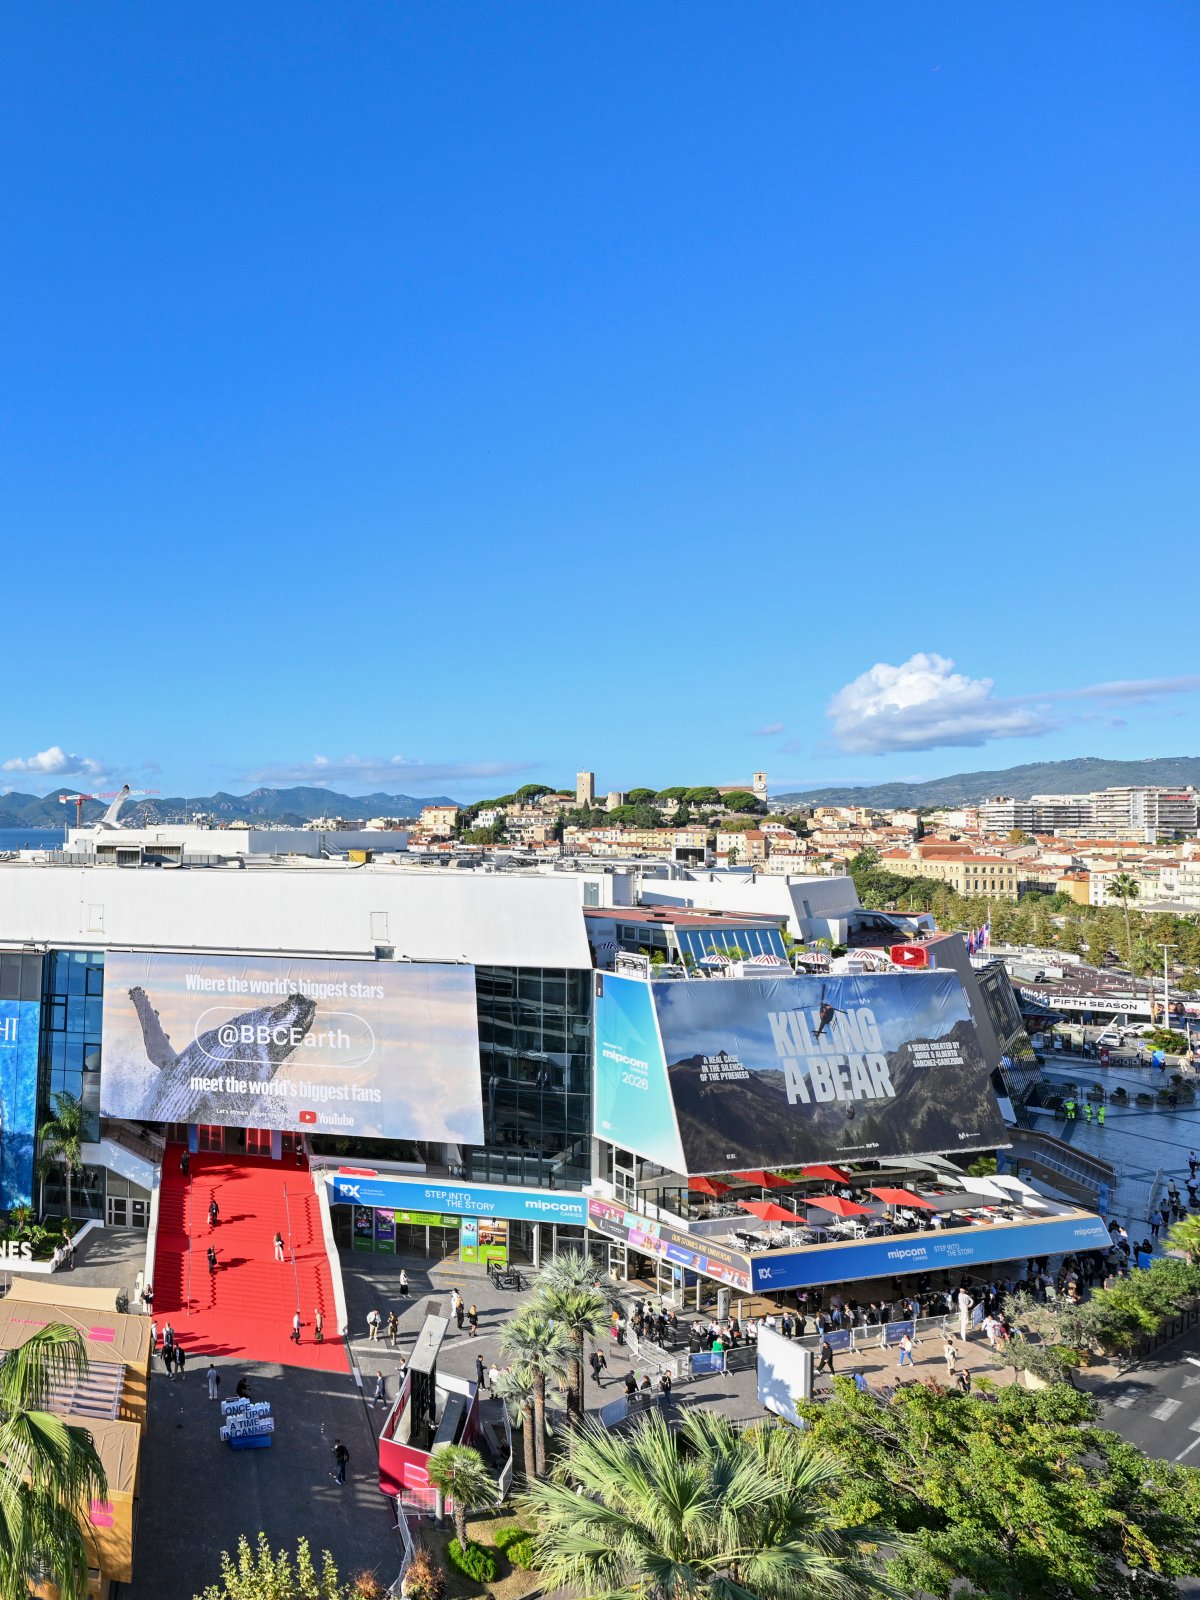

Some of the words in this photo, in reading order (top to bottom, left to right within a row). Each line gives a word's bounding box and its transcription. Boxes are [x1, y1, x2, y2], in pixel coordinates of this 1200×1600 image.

[186, 974, 225, 992] Where
[226, 978, 249, 994] the
[250, 979, 298, 995] world's
[299, 980, 348, 1000] biggest
[350, 983, 384, 999] stars
[1054, 998, 1086, 1006] FIFTH
[1090, 1001, 1138, 1010] SEASON
[218, 1024, 350, 1049] @BBCEarth
[768, 1008, 883, 1057] KILLING
[908, 1044, 912, 1052] A
[930, 1042, 952, 1050] CREATED
[603, 1050, 648, 1070] mipcom
[703, 1056, 708, 1064] A
[708, 1056, 723, 1064] REAL
[724, 1055, 739, 1063] CASE
[935, 1050, 958, 1058] ALBERTO
[701, 1064, 708, 1073] IN
[709, 1064, 720, 1072] THE
[720, 1062, 744, 1072] SILENCE
[700, 1073, 707, 1082] OF
[708, 1072, 720, 1081] THE
[720, 1070, 750, 1080] PYRENEES
[783, 1058, 812, 1104] A
[806, 1053, 896, 1102] BEAR
[190, 1075, 224, 1092] meet
[225, 1076, 247, 1094] the
[249, 1078, 298, 1098] world's
[299, 1081, 350, 1102] biggest
[351, 1084, 381, 1102] fans
[318, 1112, 354, 1126] YouTube
[340, 1184, 360, 1198] RX
[425, 1190, 447, 1199] STEP
[448, 1192, 470, 1201] INTO
[446, 1199, 462, 1208] THE
[465, 1201, 494, 1211] STORY
[525, 1200, 582, 1212] mipcom
[1074, 1227, 1103, 1236] mipcom
[672, 1234, 681, 1242] OUR
[681, 1237, 698, 1249] STORIES
[698, 1243, 708, 1253] ARE
[708, 1247, 732, 1262] UNIVERSAL
[888, 1246, 926, 1260] mipcom
[957, 1248, 974, 1256] STORY
[758, 1267, 772, 1280] RX
[225, 1403, 251, 1415] ONCE
[246, 1408, 272, 1419] UPON
[230, 1422, 236, 1430] A
[238, 1418, 260, 1428] TIME
[223, 1432, 232, 1440] IN
[235, 1424, 272, 1437] CANNES
